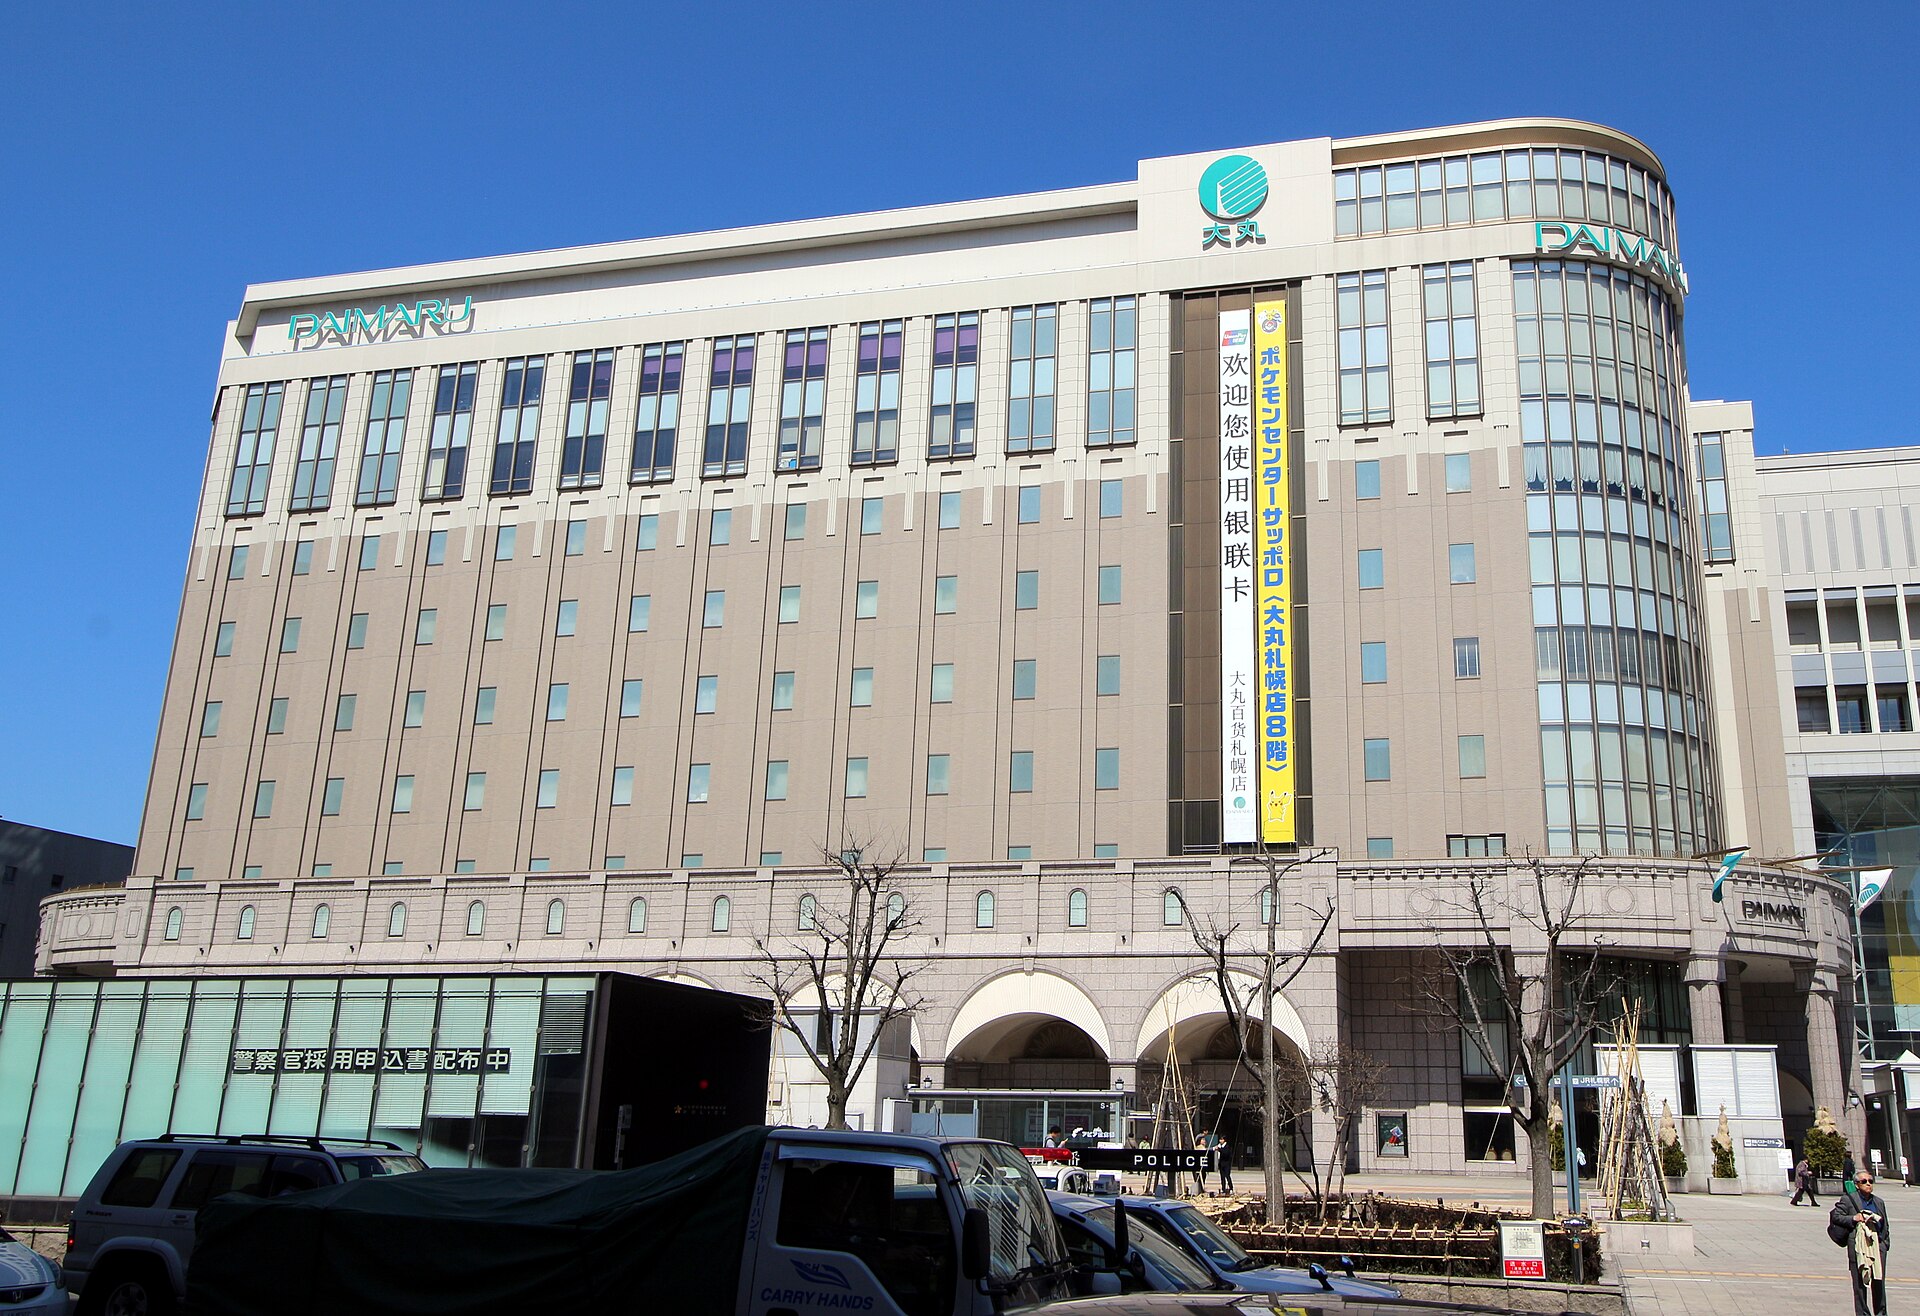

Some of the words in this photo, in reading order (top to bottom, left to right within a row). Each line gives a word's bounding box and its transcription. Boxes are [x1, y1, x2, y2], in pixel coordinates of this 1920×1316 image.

[1202, 219, 1265, 246] 大丸
[1535, 222, 1687, 294] DAIMAR
[288, 296, 471, 340] DAIMARU
[1222, 353, 1251, 602] 欢迎您使用银联卡
[1229, 671, 1247, 792] 大丸百货札幌店
[1742, 900, 1807, 921] DAIMARU
[233, 1050, 509, 1071] 警察官採用申込書配布中
[1134, 1155, 1209, 1167] POLICE
[761, 1288, 814, 1305] CARRY
[817, 1292, 874, 1310] HANDS
